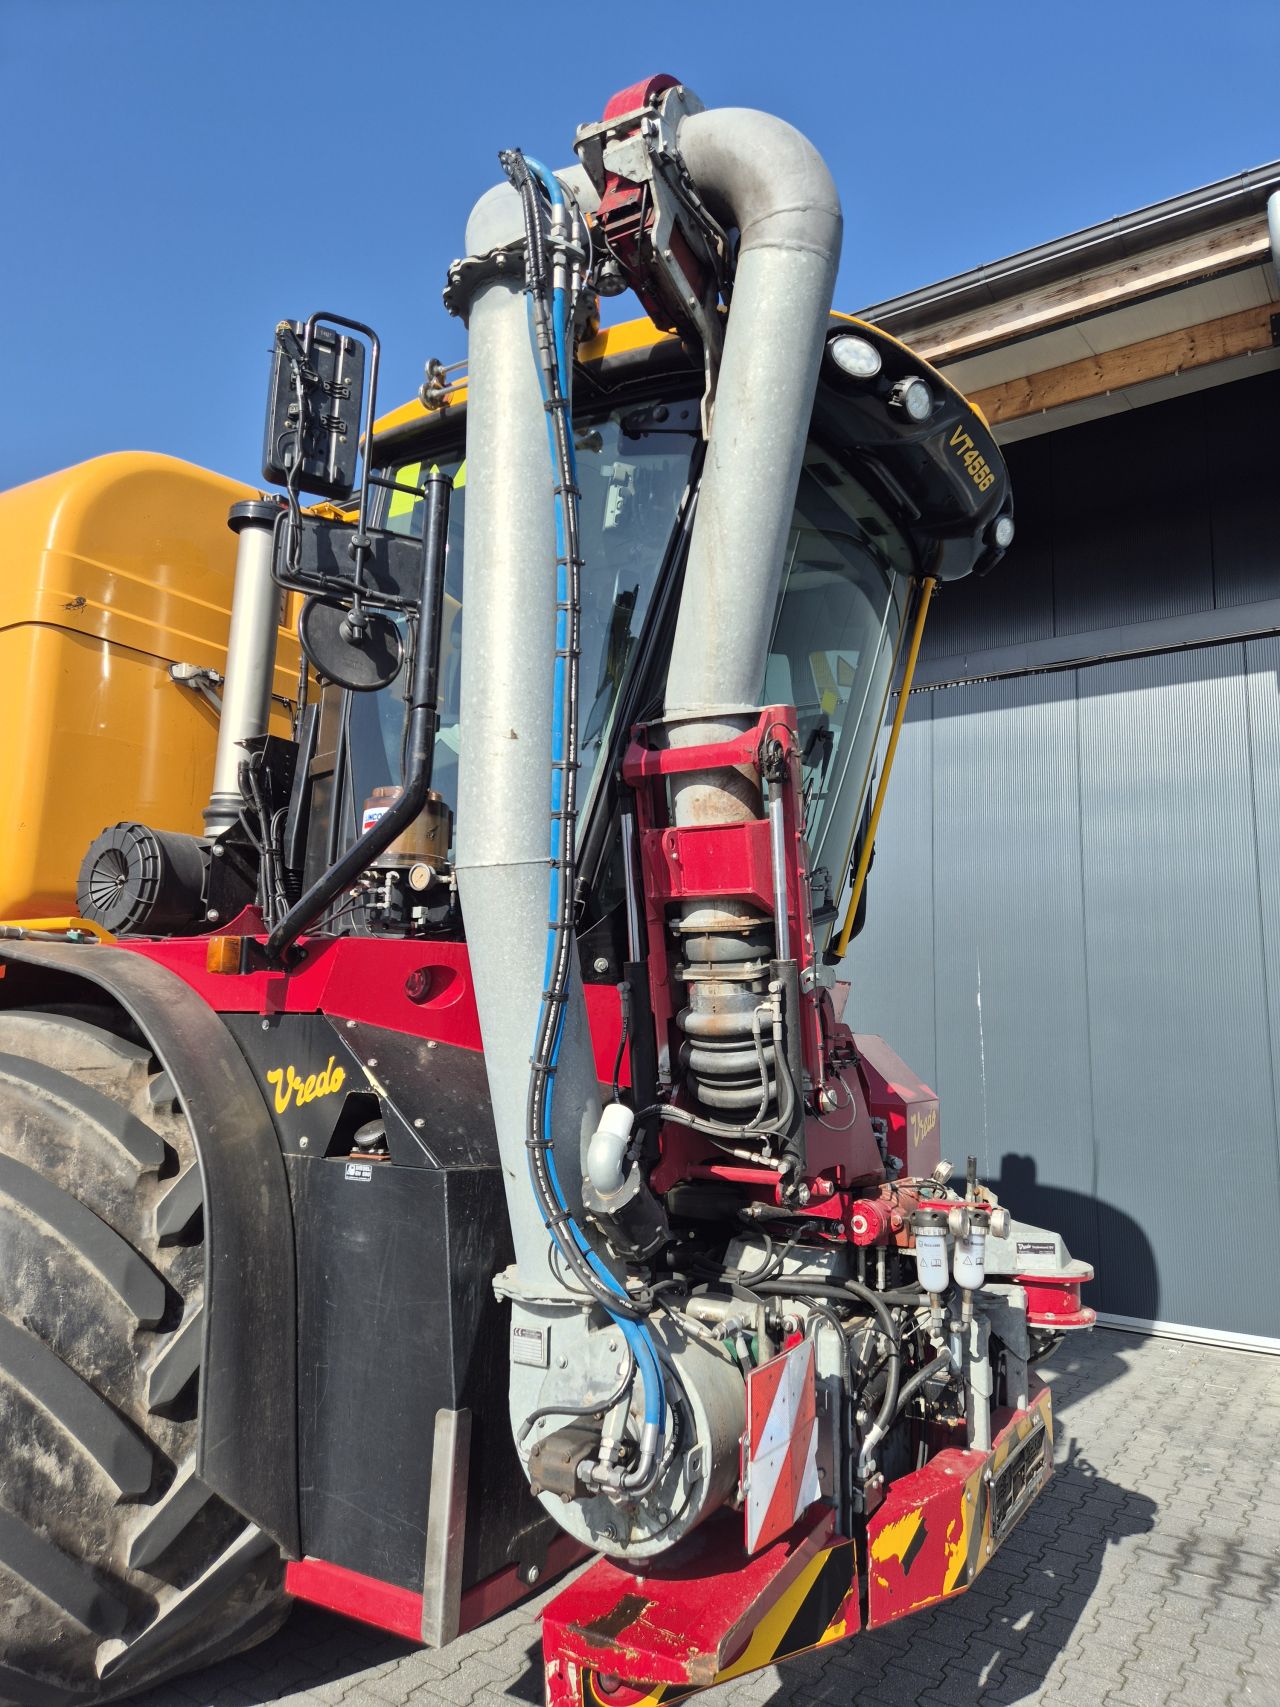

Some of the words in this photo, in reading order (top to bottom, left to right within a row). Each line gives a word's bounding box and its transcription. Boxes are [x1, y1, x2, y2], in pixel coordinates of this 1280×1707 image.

[949, 424, 995, 492] VT4556
[266, 1055, 346, 1114] Vredo
[910, 1103, 937, 1148] Vredo
